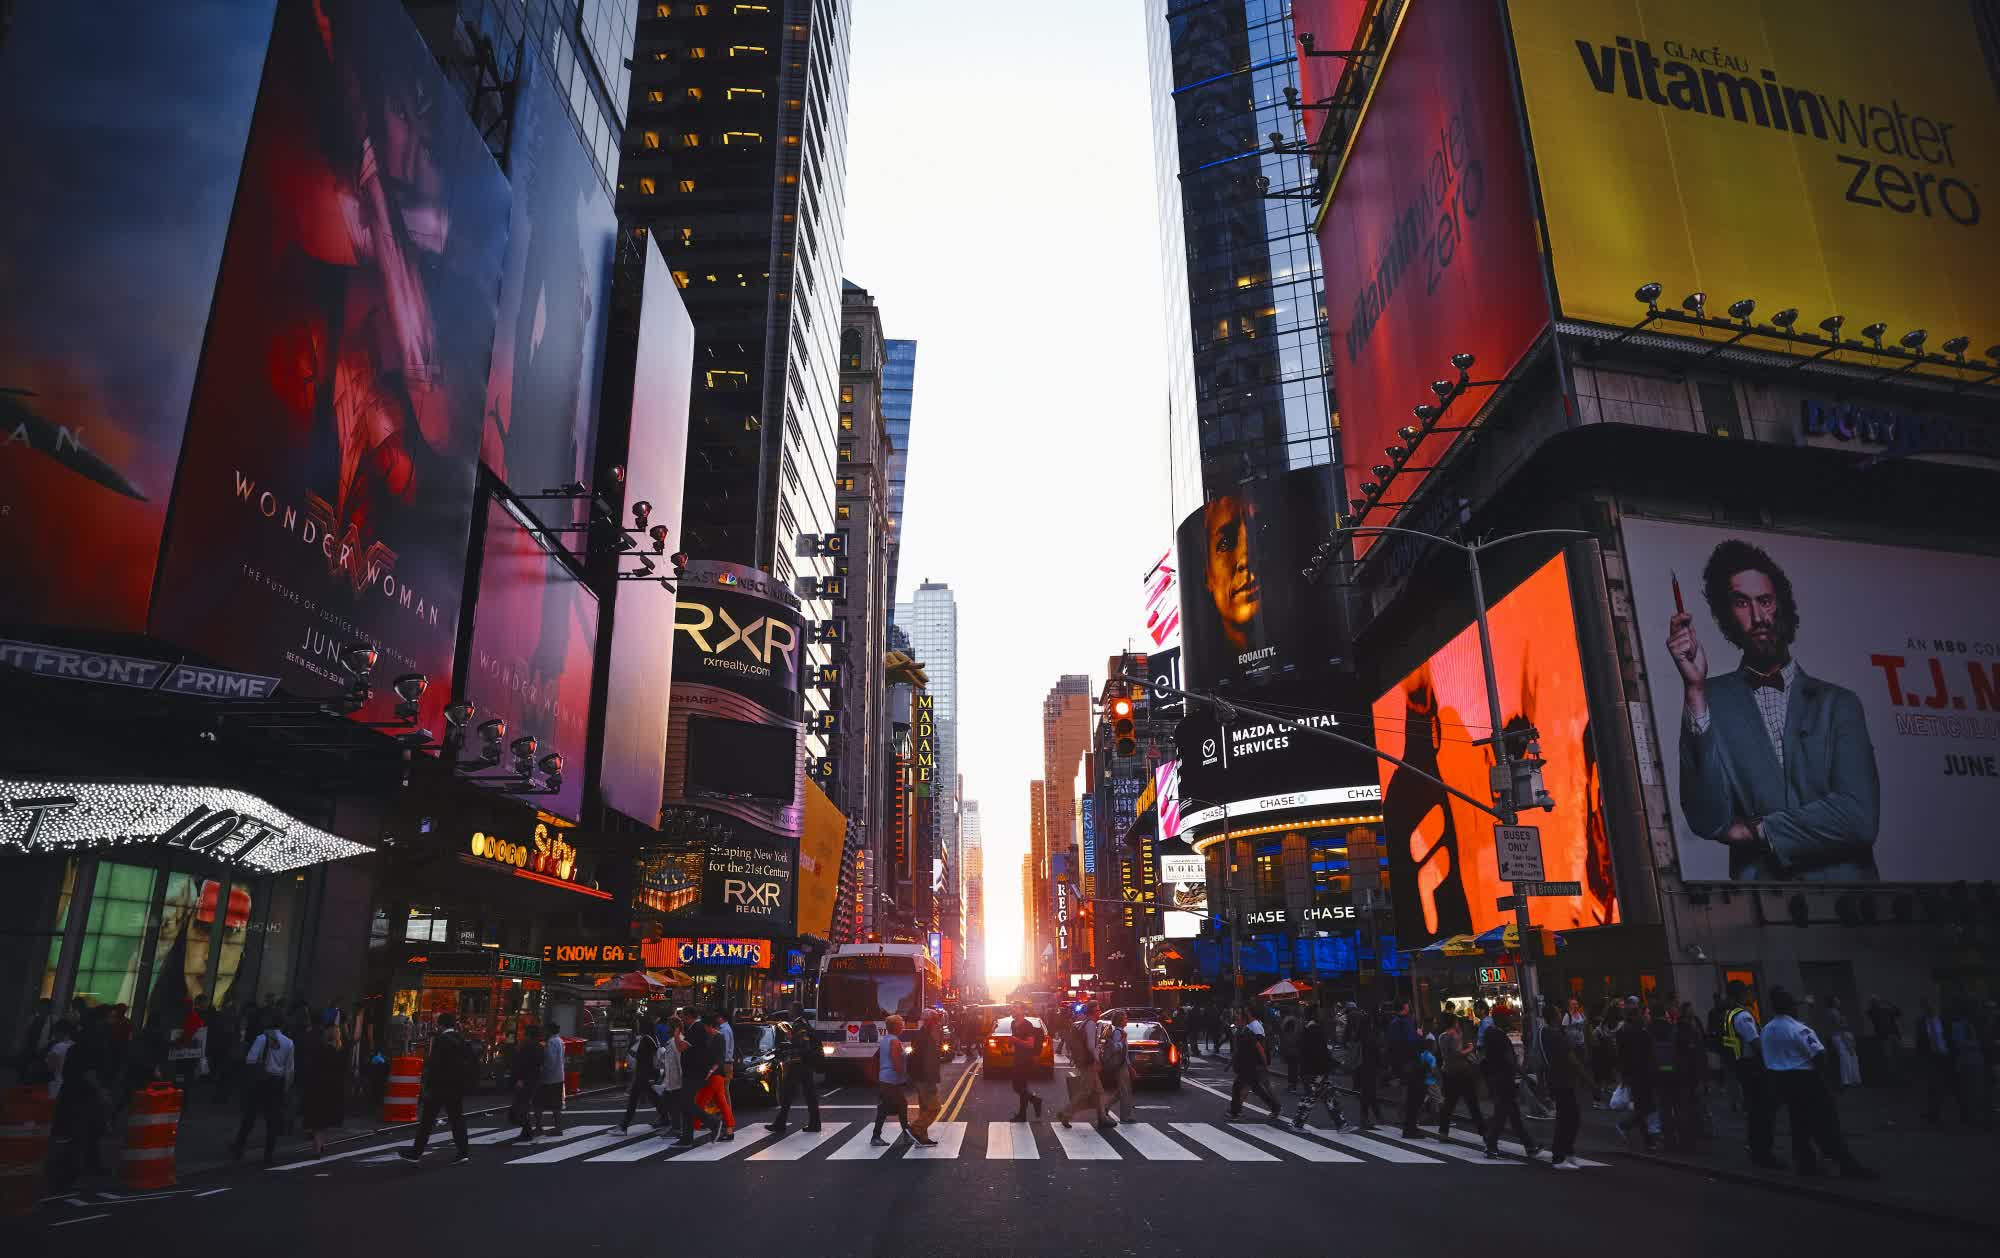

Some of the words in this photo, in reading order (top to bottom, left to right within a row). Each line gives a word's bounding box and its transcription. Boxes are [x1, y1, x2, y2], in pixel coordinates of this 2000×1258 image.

[1664, 41, 1750, 73] GLACÉAU
[1838, 155, 1981, 226] zero
[1424, 160, 1484, 297] zero
[235, 470, 351, 568] WONDER
[367, 560, 438, 625] WOMAN
[242, 563, 261, 581] THE
[267, 577, 300, 604] FUTURE
[304, 598, 316, 610] OF
[320, 608, 351, 633] JUSTICE
[302, 627, 348, 663] JUN
[674, 602, 796, 673] RXR
[703, 656, 771, 678] rxrrealty.com
[823, 537, 841, 776] CHAMPS
[1238, 646, 1276, 664] EQUALITY.
[177, 669, 266, 697] PRIME
[480, 649, 537, 703] WONDER
[672, 694, 718, 704] SHARP
[918, 696, 932, 781] MADAME
[1233, 723, 1274, 741] MAZDA
[1233, 736, 1289, 756] SERVICES
[1944, 753, 1998, 777] JUNE
[1202, 808, 1224, 820] CHASE
[1260, 796, 1295, 809] CHASE
[1504, 831, 1531, 840] BUSES
[1508, 843, 1528, 852] ONLY
[754, 848, 773, 860] New
[774, 850, 788, 863] York
[1143, 837, 1154, 885] VICTORY
[708, 860, 726, 872] for
[727, 861, 744, 872] the
[745, 863, 763, 874] 21st
[763, 865, 790, 882] Century
[1168, 864, 1204, 873] WORK
[723, 879, 780, 907] RXR
[736, 904, 772, 915] REALTY
[1057, 884, 1068, 949] REGAL
[1304, 906, 1356, 921] CHASE
[556, 945, 598, 961] KNOW
[678, 943, 761, 963] CHAMPS
[1481, 968, 1507, 982] SODA
